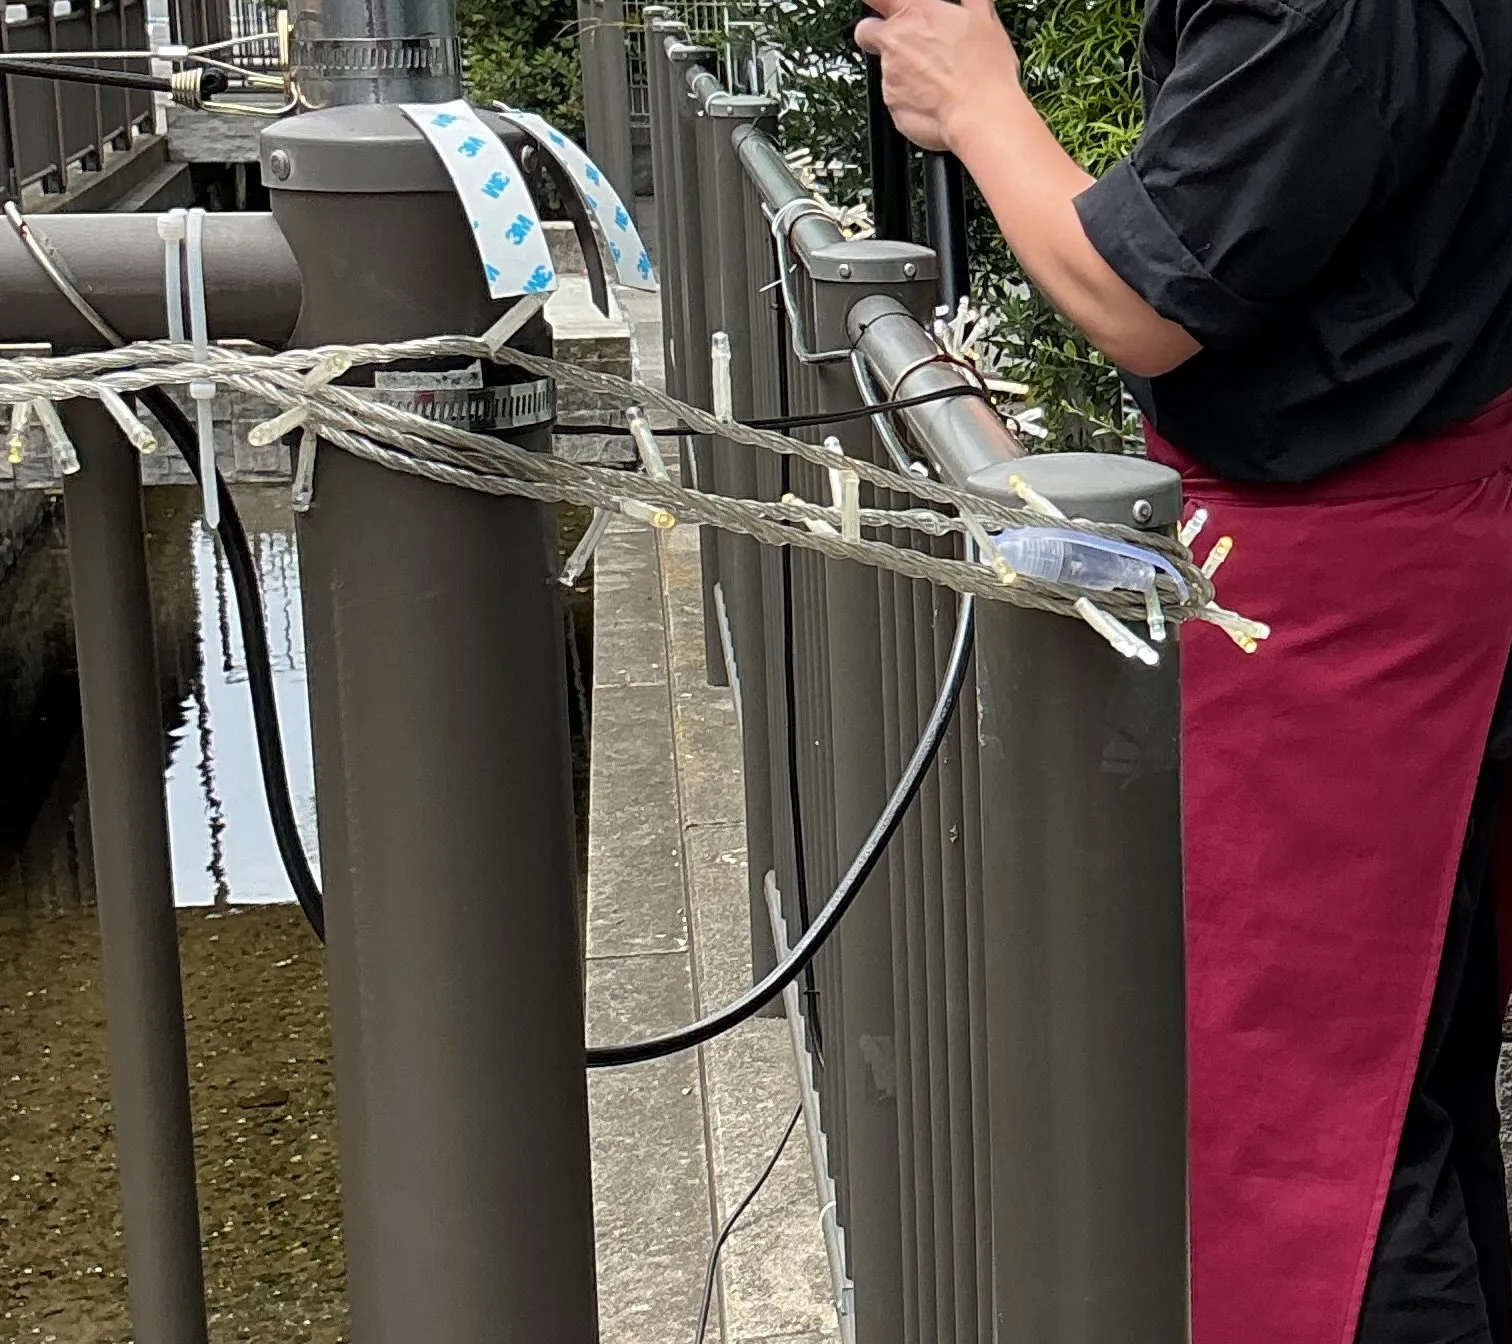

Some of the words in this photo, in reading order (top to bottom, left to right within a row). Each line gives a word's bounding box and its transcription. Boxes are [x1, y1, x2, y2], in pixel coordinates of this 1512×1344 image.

[457, 136, 487, 158] 3M
[481, 171, 511, 200] 3M
[505, 213, 535, 246] 3M
